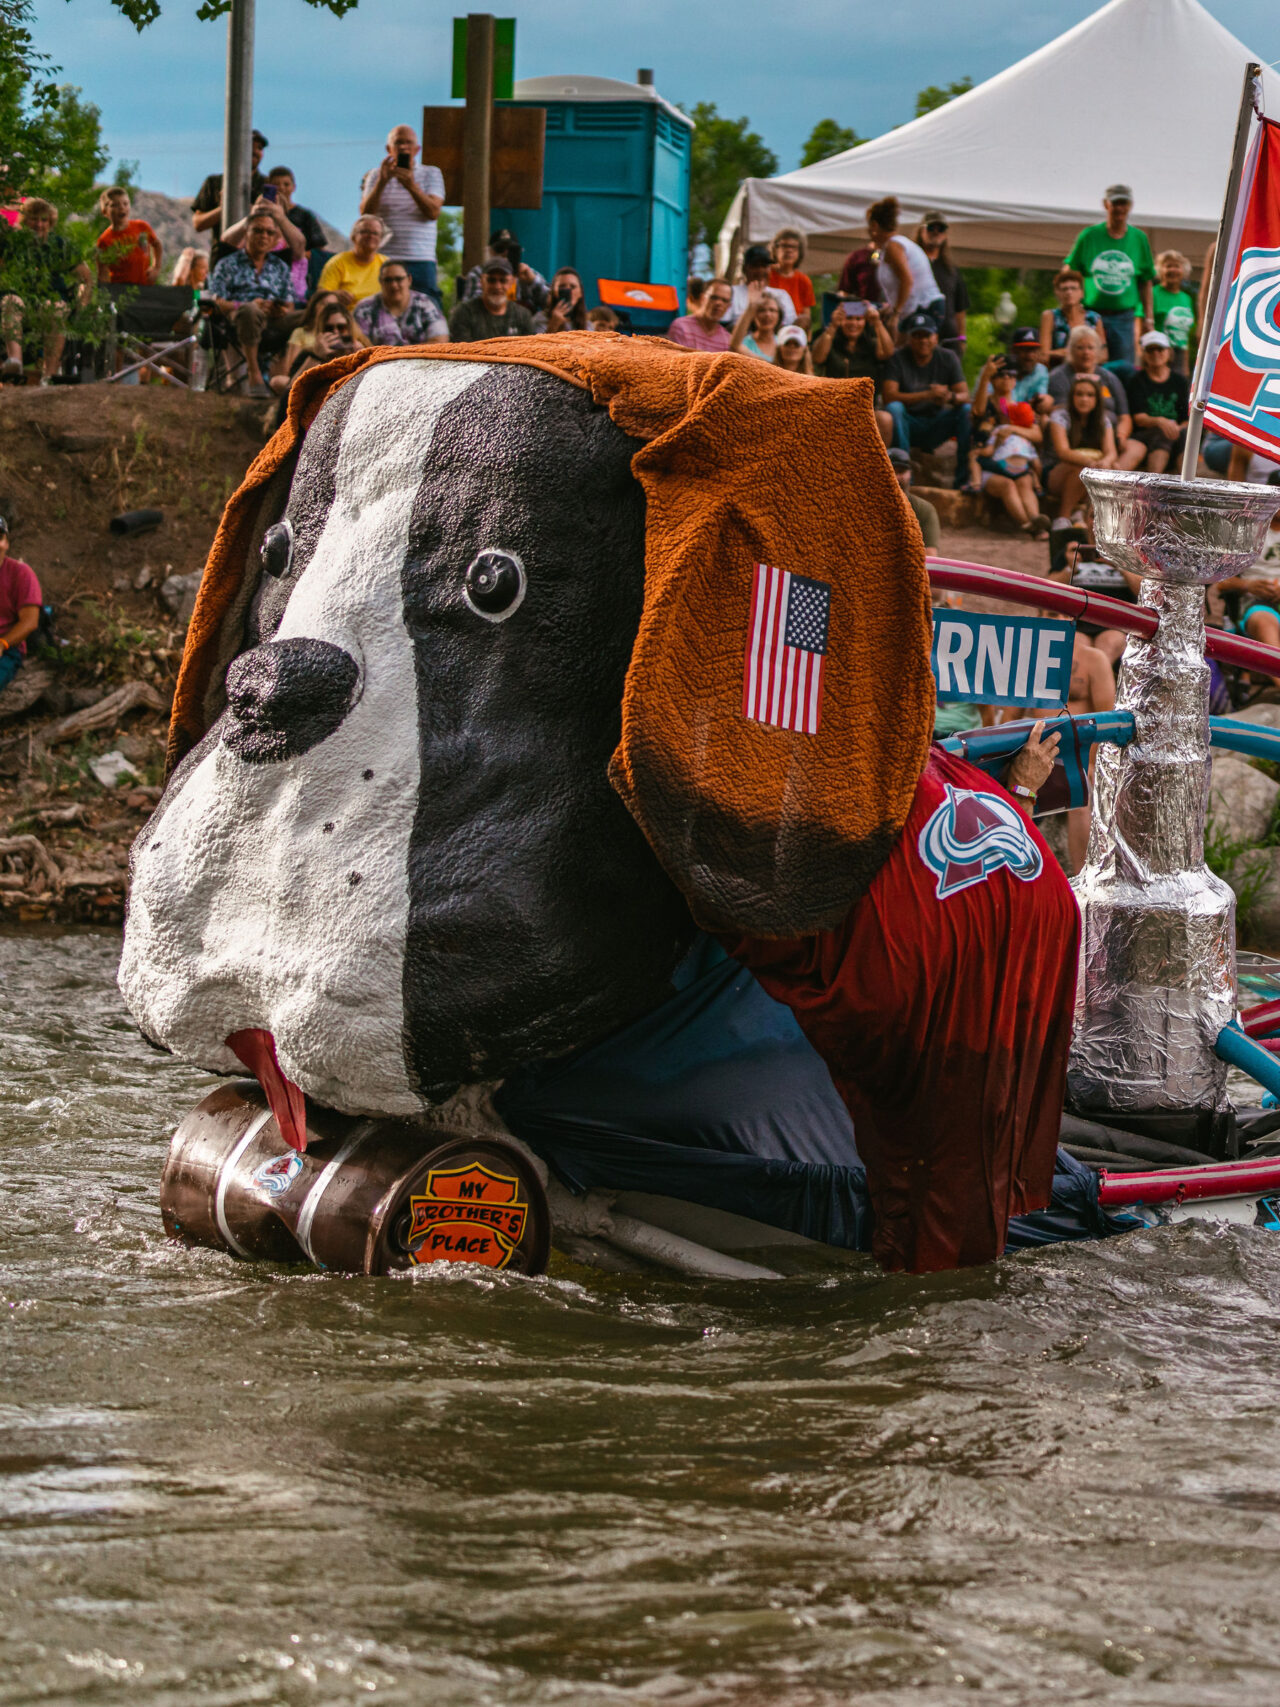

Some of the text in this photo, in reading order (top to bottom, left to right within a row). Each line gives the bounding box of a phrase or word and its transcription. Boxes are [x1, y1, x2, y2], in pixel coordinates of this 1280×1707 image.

[932, 620, 1066, 700] RNIE
[458, 1180, 489, 1199] MY
[415, 1205, 522, 1234] BROTHER'S
[431, 1234, 491, 1254] PLACE
